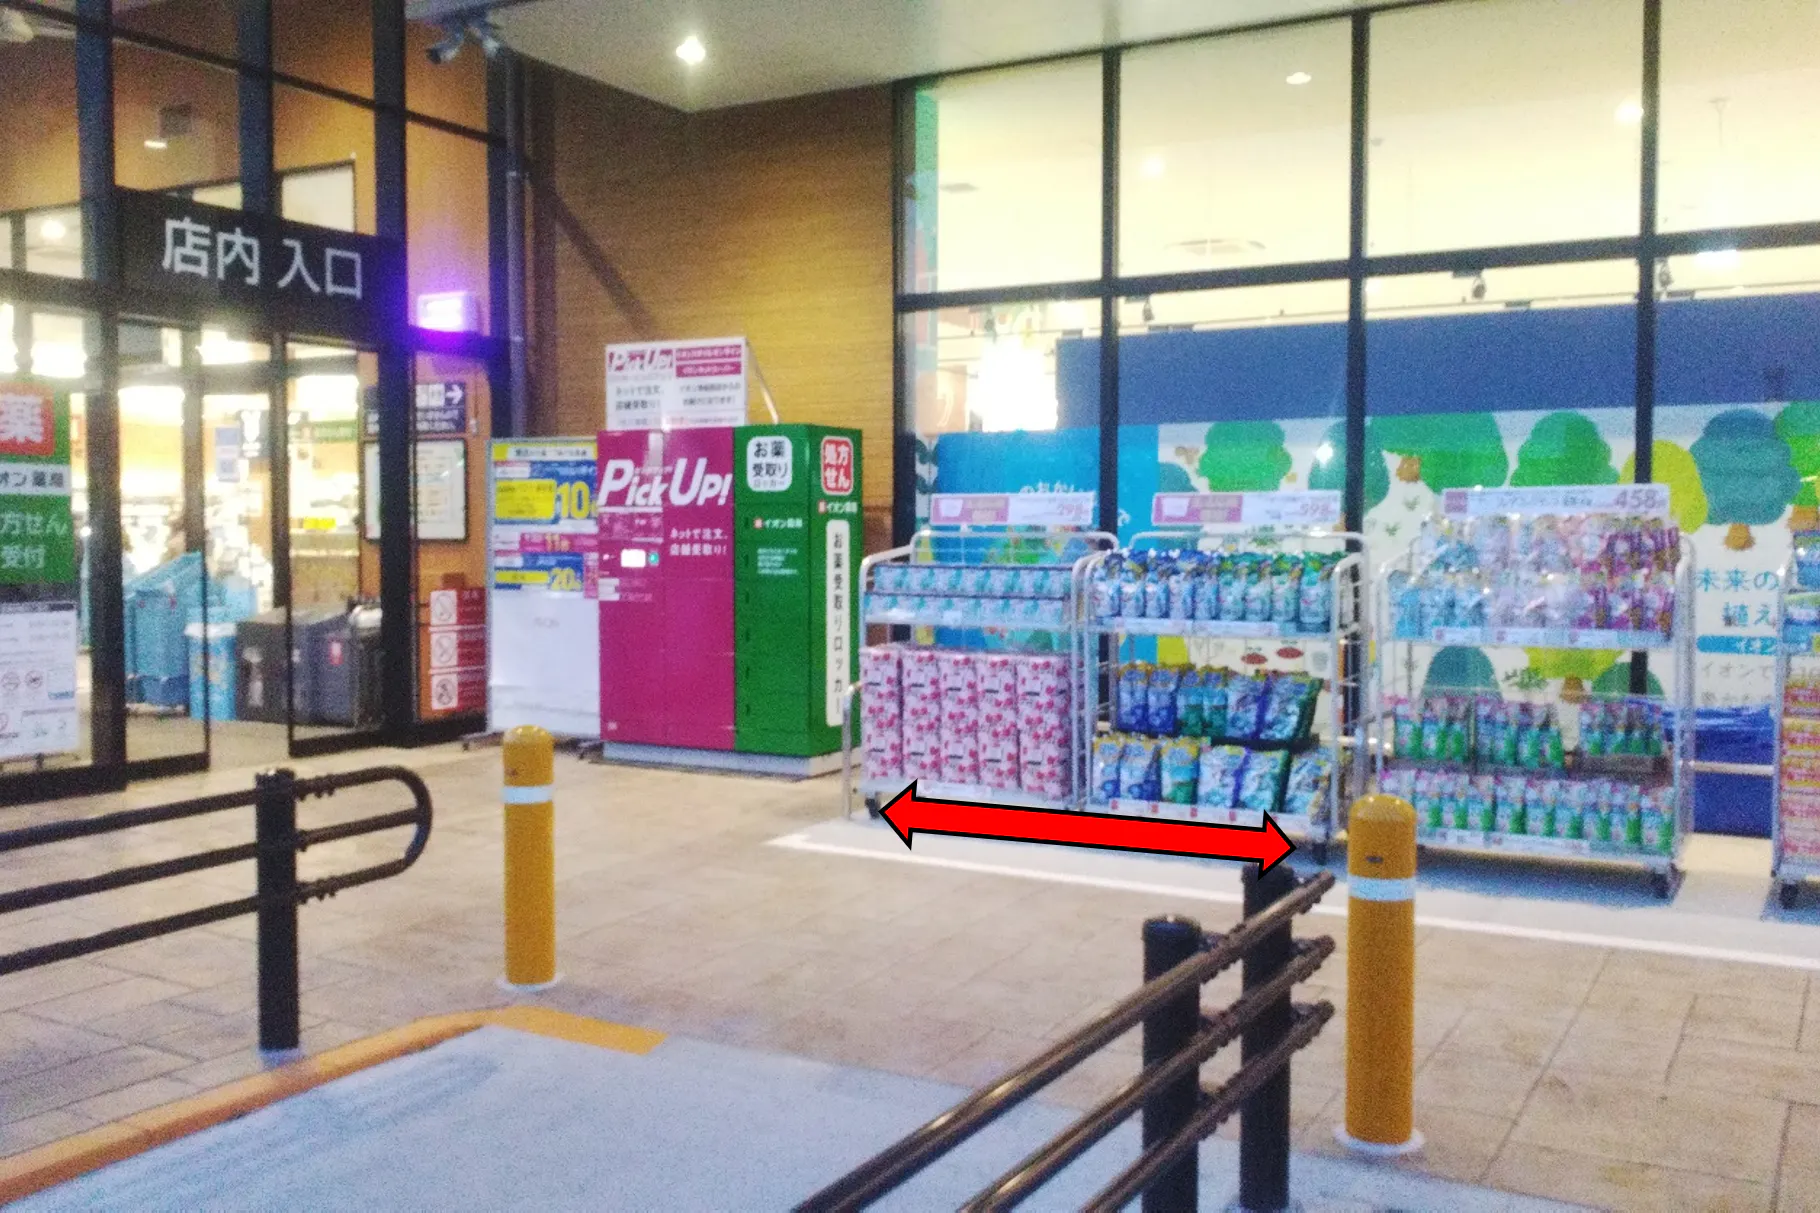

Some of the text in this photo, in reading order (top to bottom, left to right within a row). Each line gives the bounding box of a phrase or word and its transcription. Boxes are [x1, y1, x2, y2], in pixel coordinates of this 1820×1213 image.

[162, 216, 363, 300] 店内 入口
[753, 440, 785, 458] お薬
[824, 443, 850, 467] 処方
[752, 462, 788, 479] 受取り
[824, 467, 850, 490] せん
[1614, 488, 1658, 510] 458
[1696, 568, 1779, 592] 未来の
